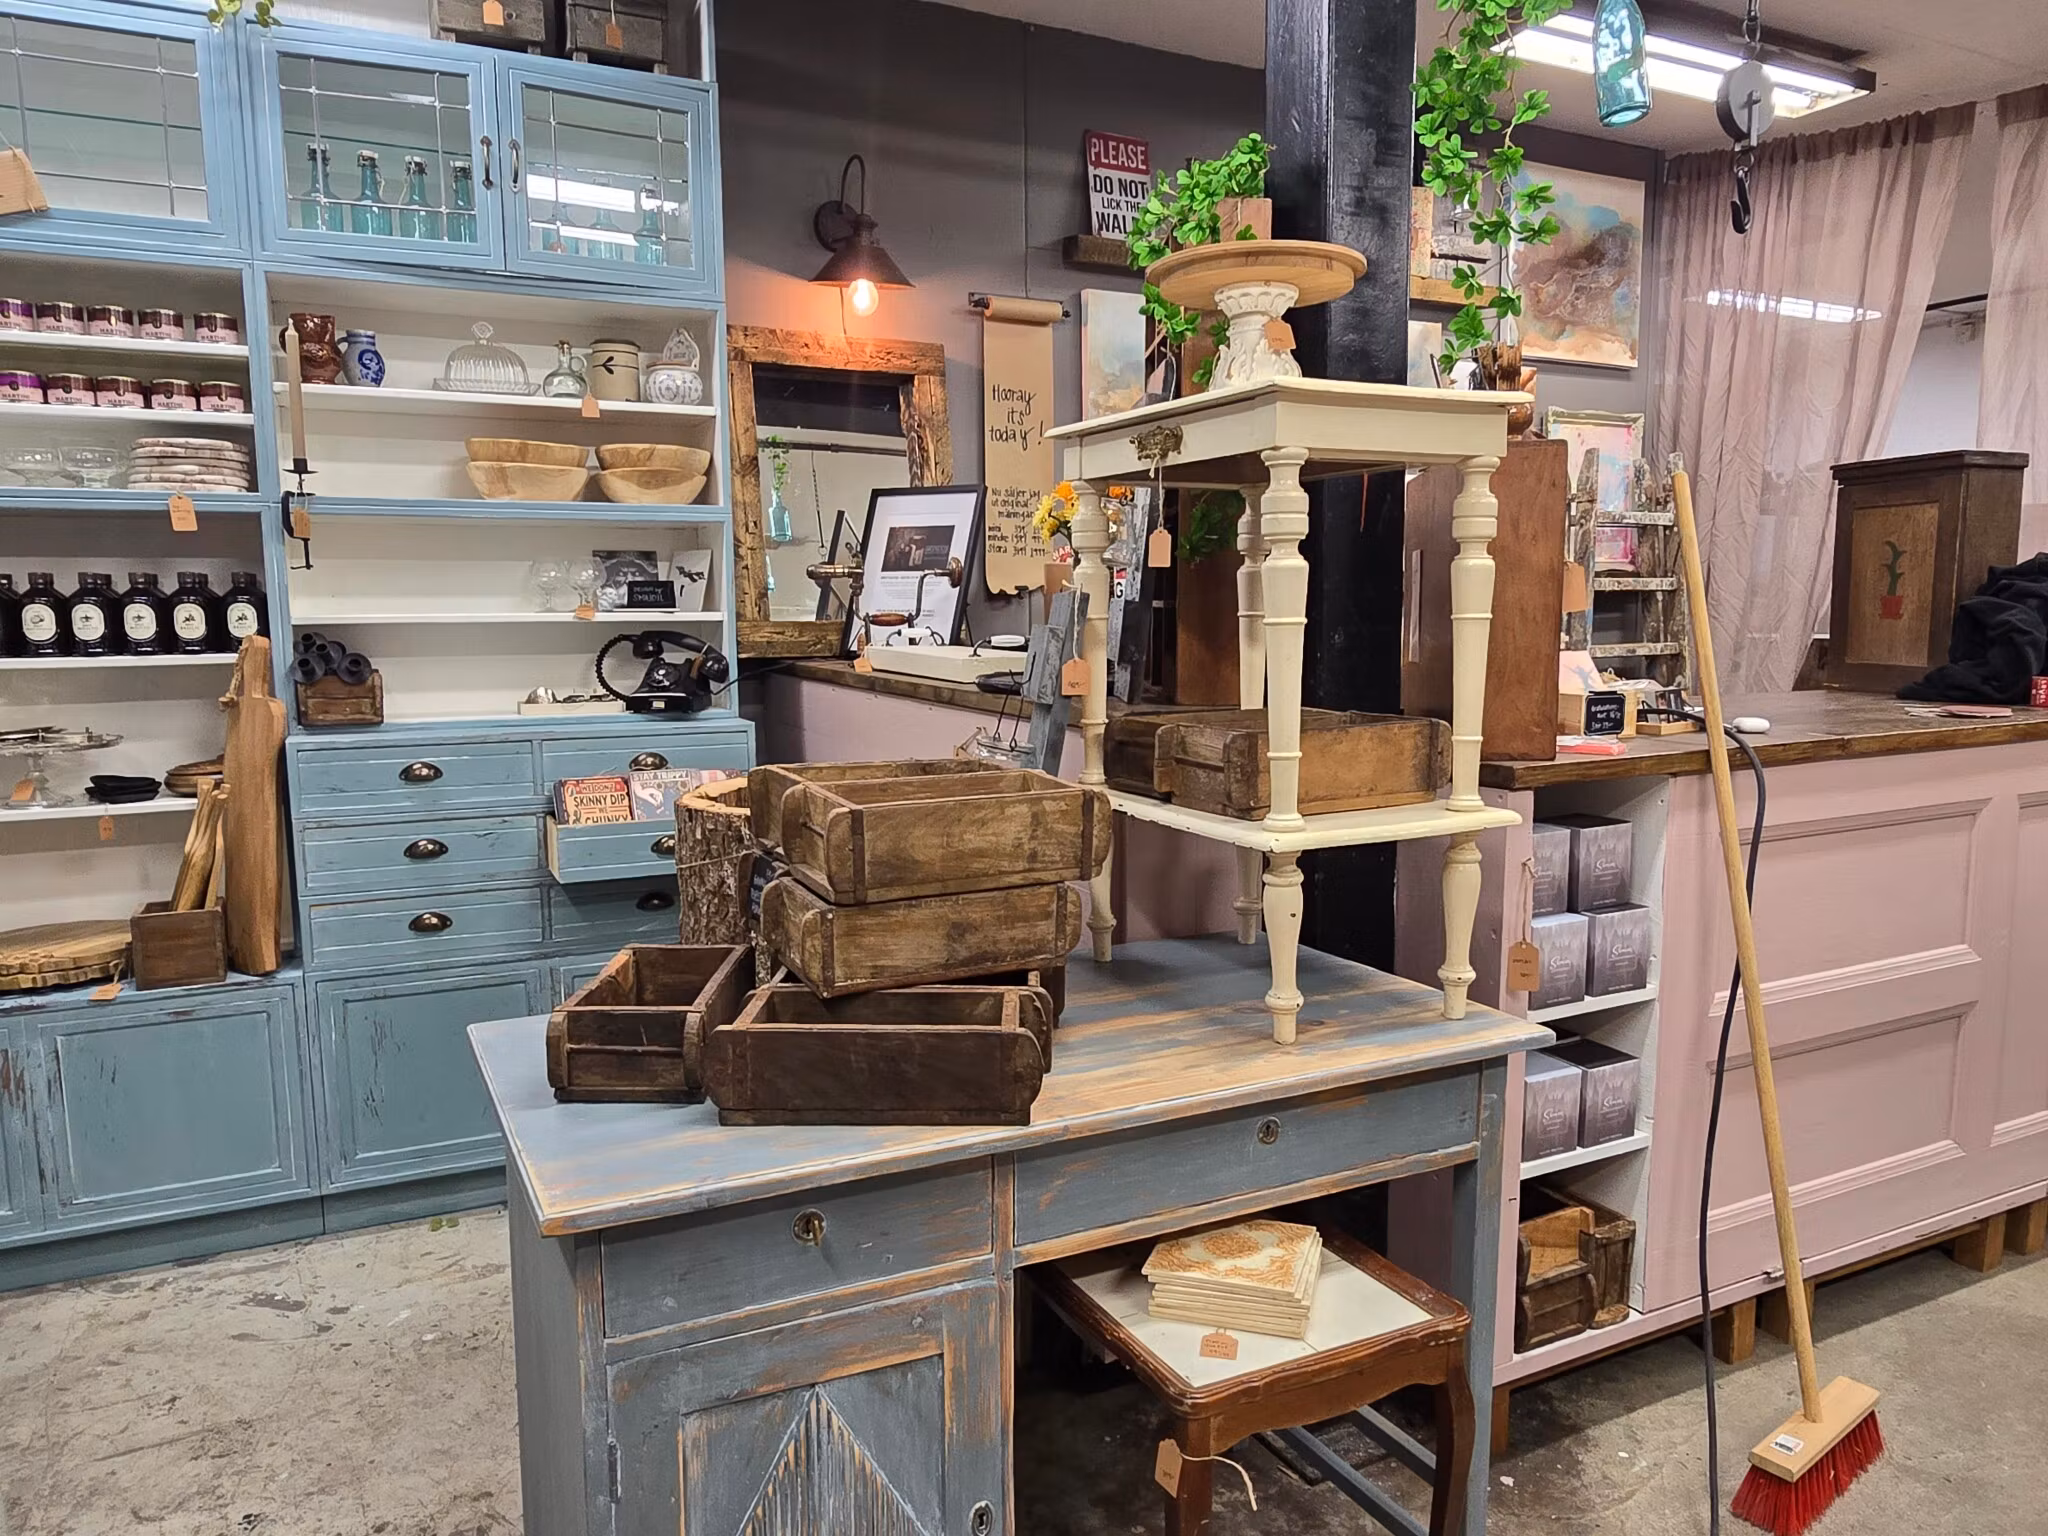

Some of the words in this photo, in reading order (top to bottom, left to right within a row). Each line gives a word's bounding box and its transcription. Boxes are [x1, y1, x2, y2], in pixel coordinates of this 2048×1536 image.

[1091, 138, 1146, 170] PLEASE
[1093, 174, 1113, 195] DO
[1118, 178, 1147, 200] NOT
[1102, 197, 1122, 211] LICK
[992, 384, 1037, 416] Hooray
[634, 772, 654, 781] STAY
[657, 770, 686, 780] TRIPPY
[581, 784, 592, 792] WE
[574, 795, 607, 807] SKINNY
[611, 794, 626, 805] DIP
